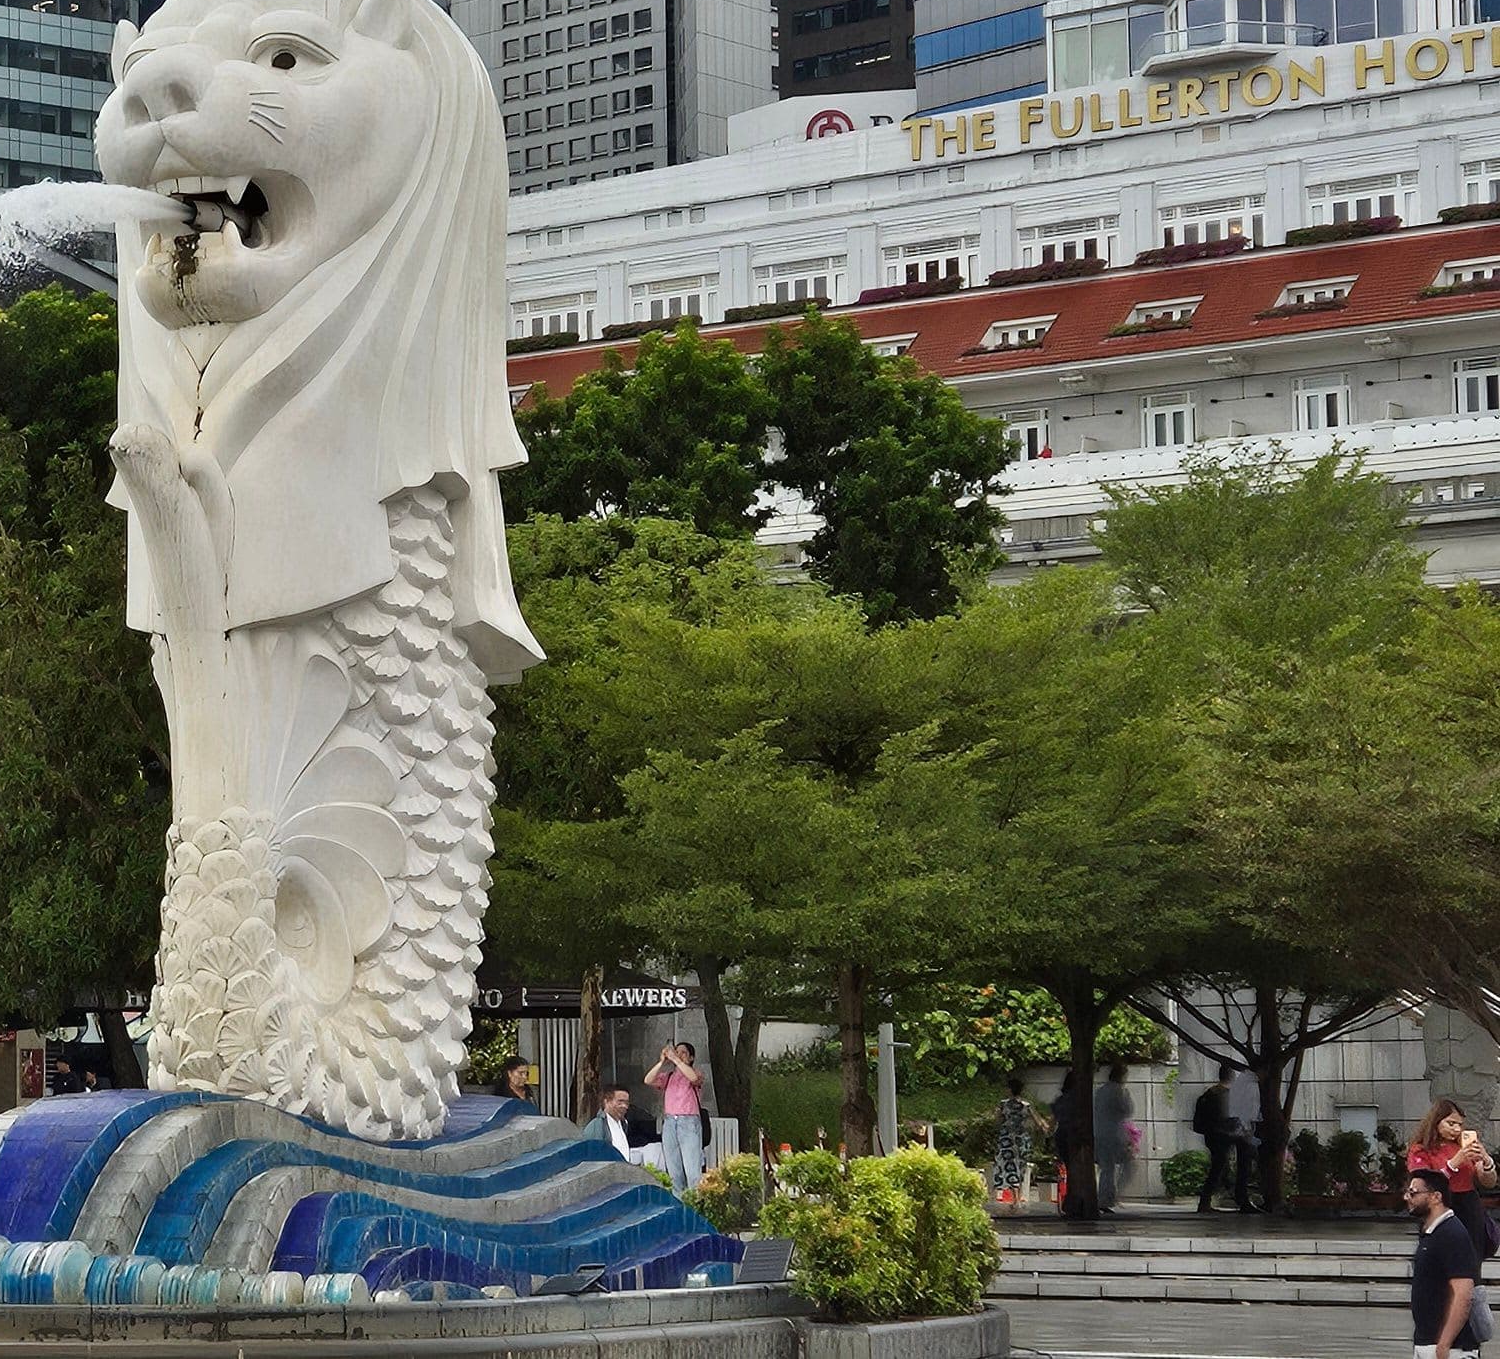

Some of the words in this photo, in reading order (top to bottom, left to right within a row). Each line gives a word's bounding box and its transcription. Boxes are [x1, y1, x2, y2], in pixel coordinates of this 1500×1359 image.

[901, 111, 997, 162] THE
[1020, 55, 1325, 144] FULLERTON
[1354, 27, 1500, 90] HOT
